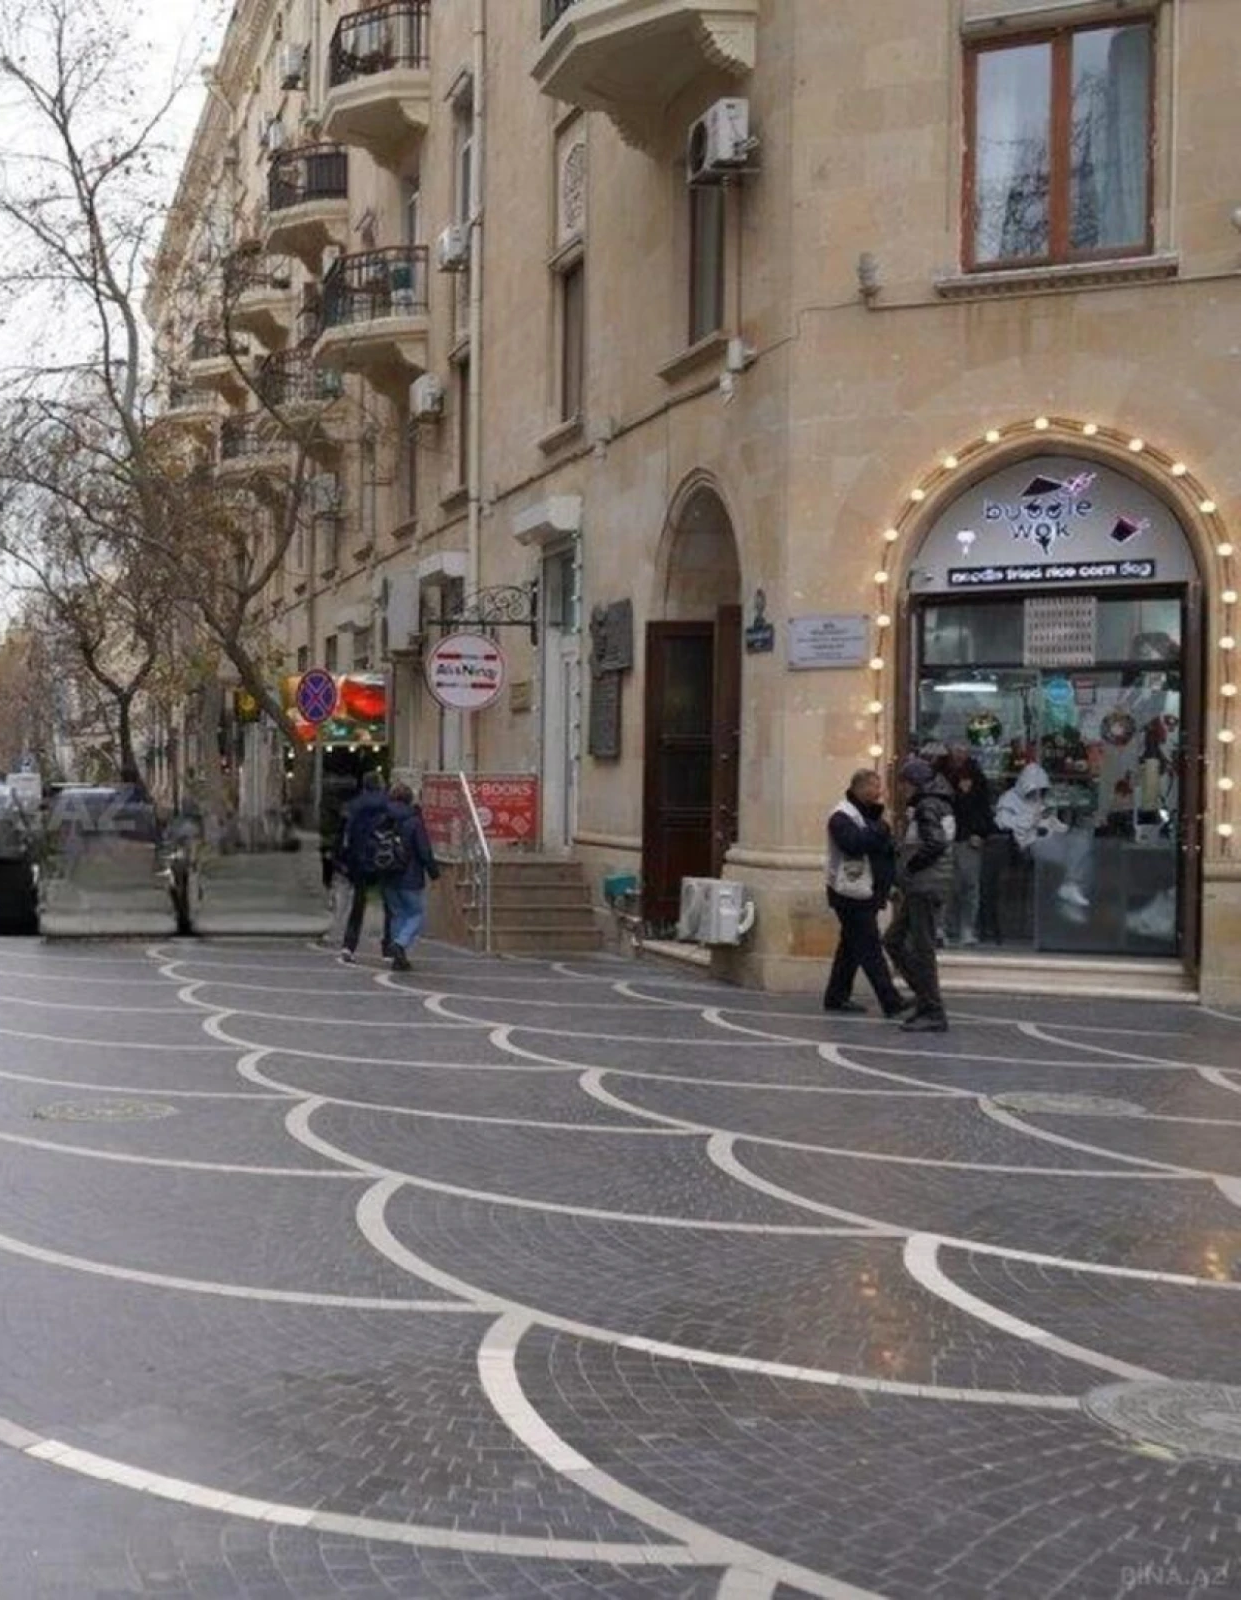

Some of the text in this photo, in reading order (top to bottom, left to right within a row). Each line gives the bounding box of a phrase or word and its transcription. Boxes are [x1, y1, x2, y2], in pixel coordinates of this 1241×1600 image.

[1011, 521, 1070, 540] wok
[952, 562, 1151, 583] noodle fried rice corn dog
